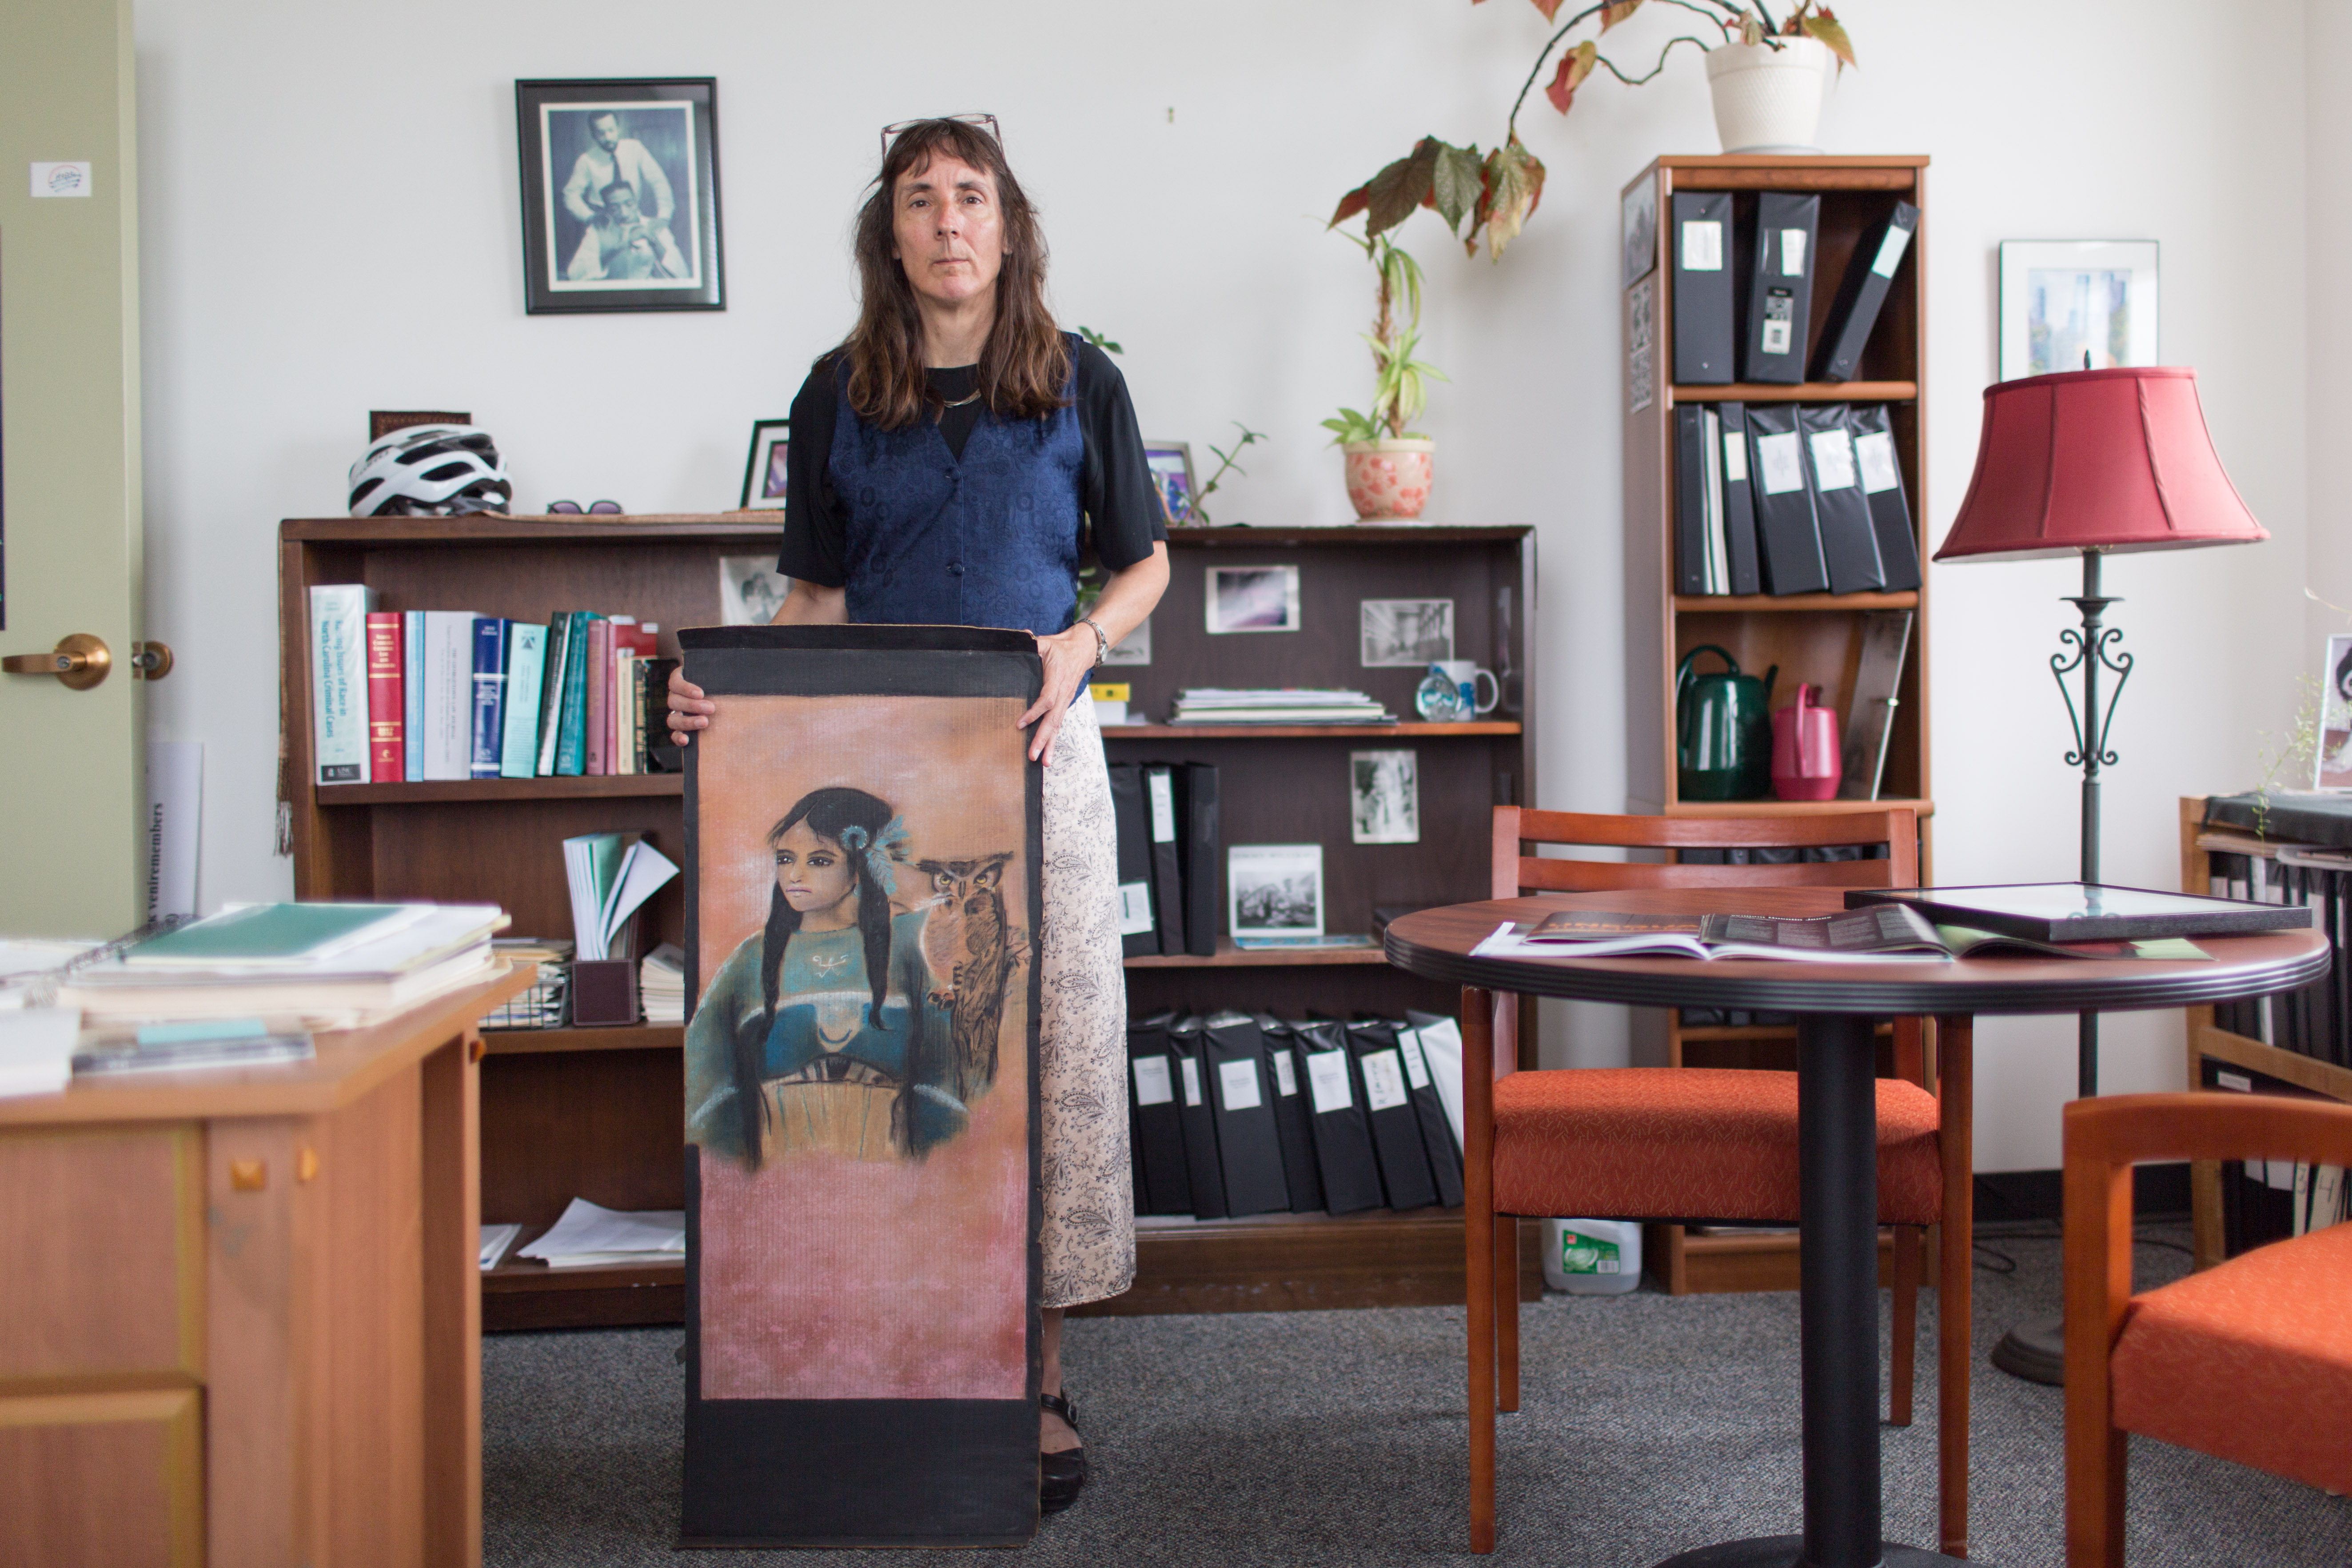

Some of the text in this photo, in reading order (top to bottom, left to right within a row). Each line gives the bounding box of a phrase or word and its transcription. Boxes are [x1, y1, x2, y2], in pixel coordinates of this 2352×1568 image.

[323, 645, 332, 678] Carolina
[324, 680, 333, 714] Criminal
[326, 715, 334, 738] Cases
[2319, 1175, 2336, 1202] 4
